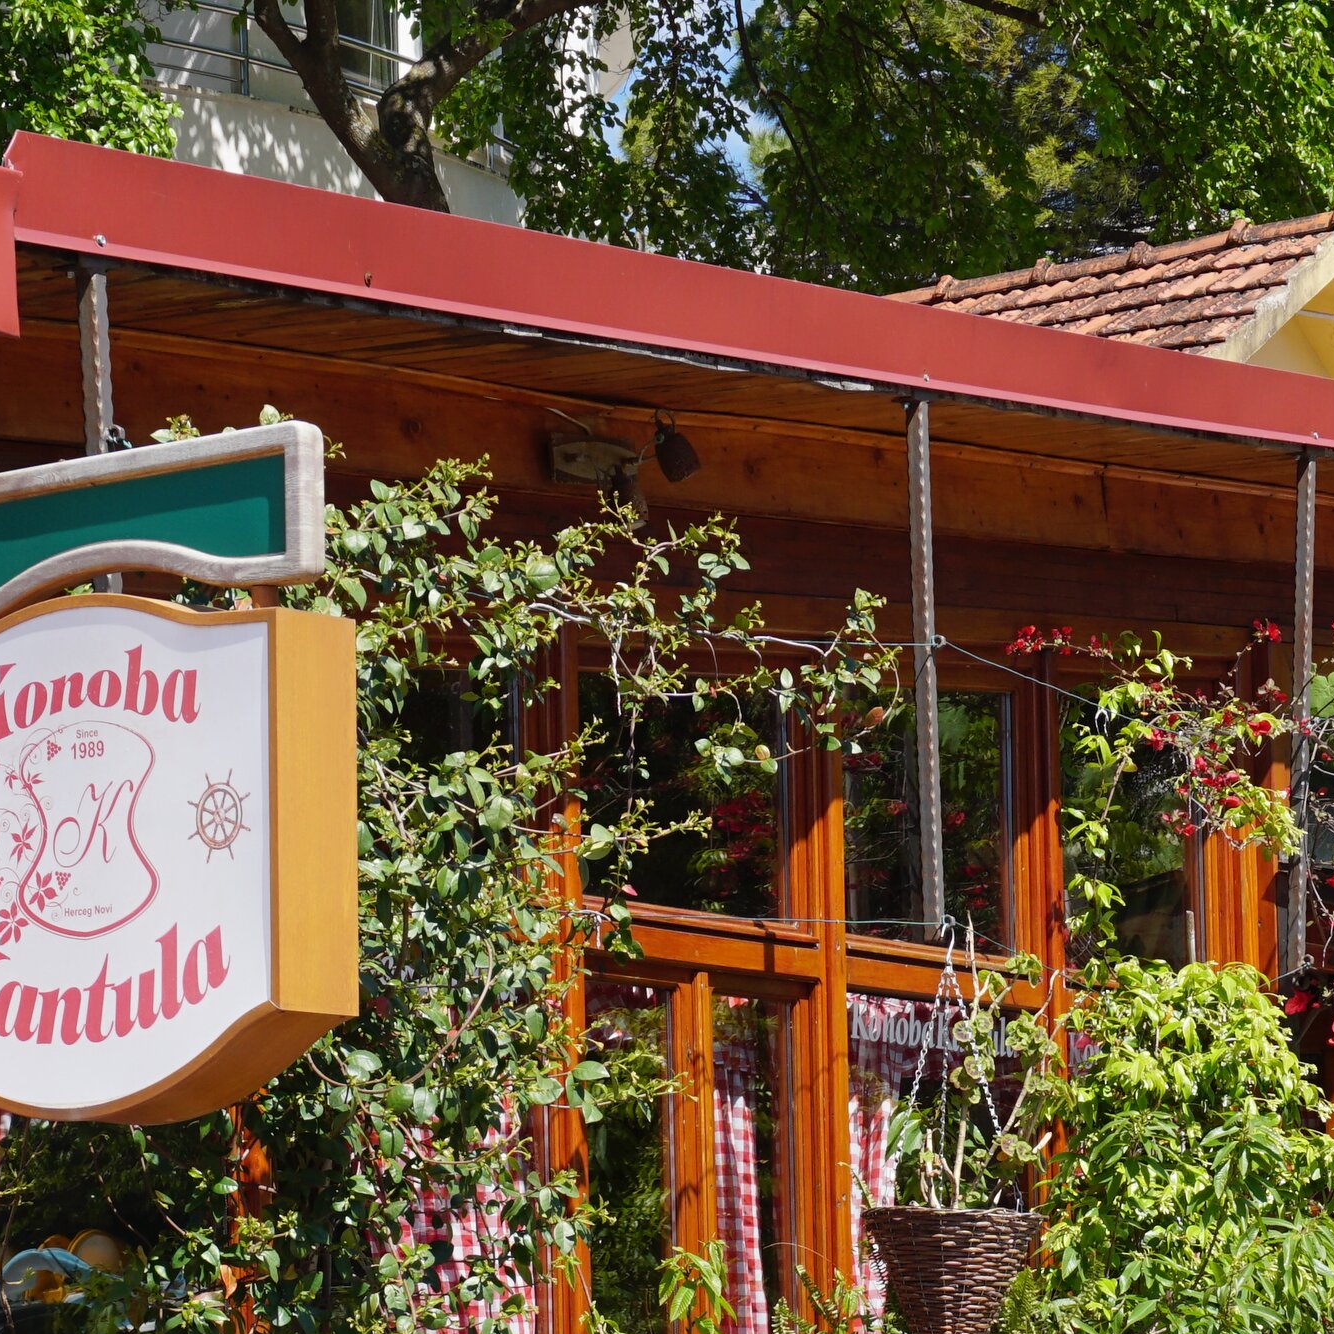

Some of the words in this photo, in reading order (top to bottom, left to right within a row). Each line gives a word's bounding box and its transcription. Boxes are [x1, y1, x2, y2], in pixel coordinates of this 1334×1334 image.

[75, 727, 99, 740] Since
[70, 739, 105, 761] 1989
[53, 780, 134, 868] K
[63, 904, 93, 919] Herceg
[95, 903, 113, 915] Novi
